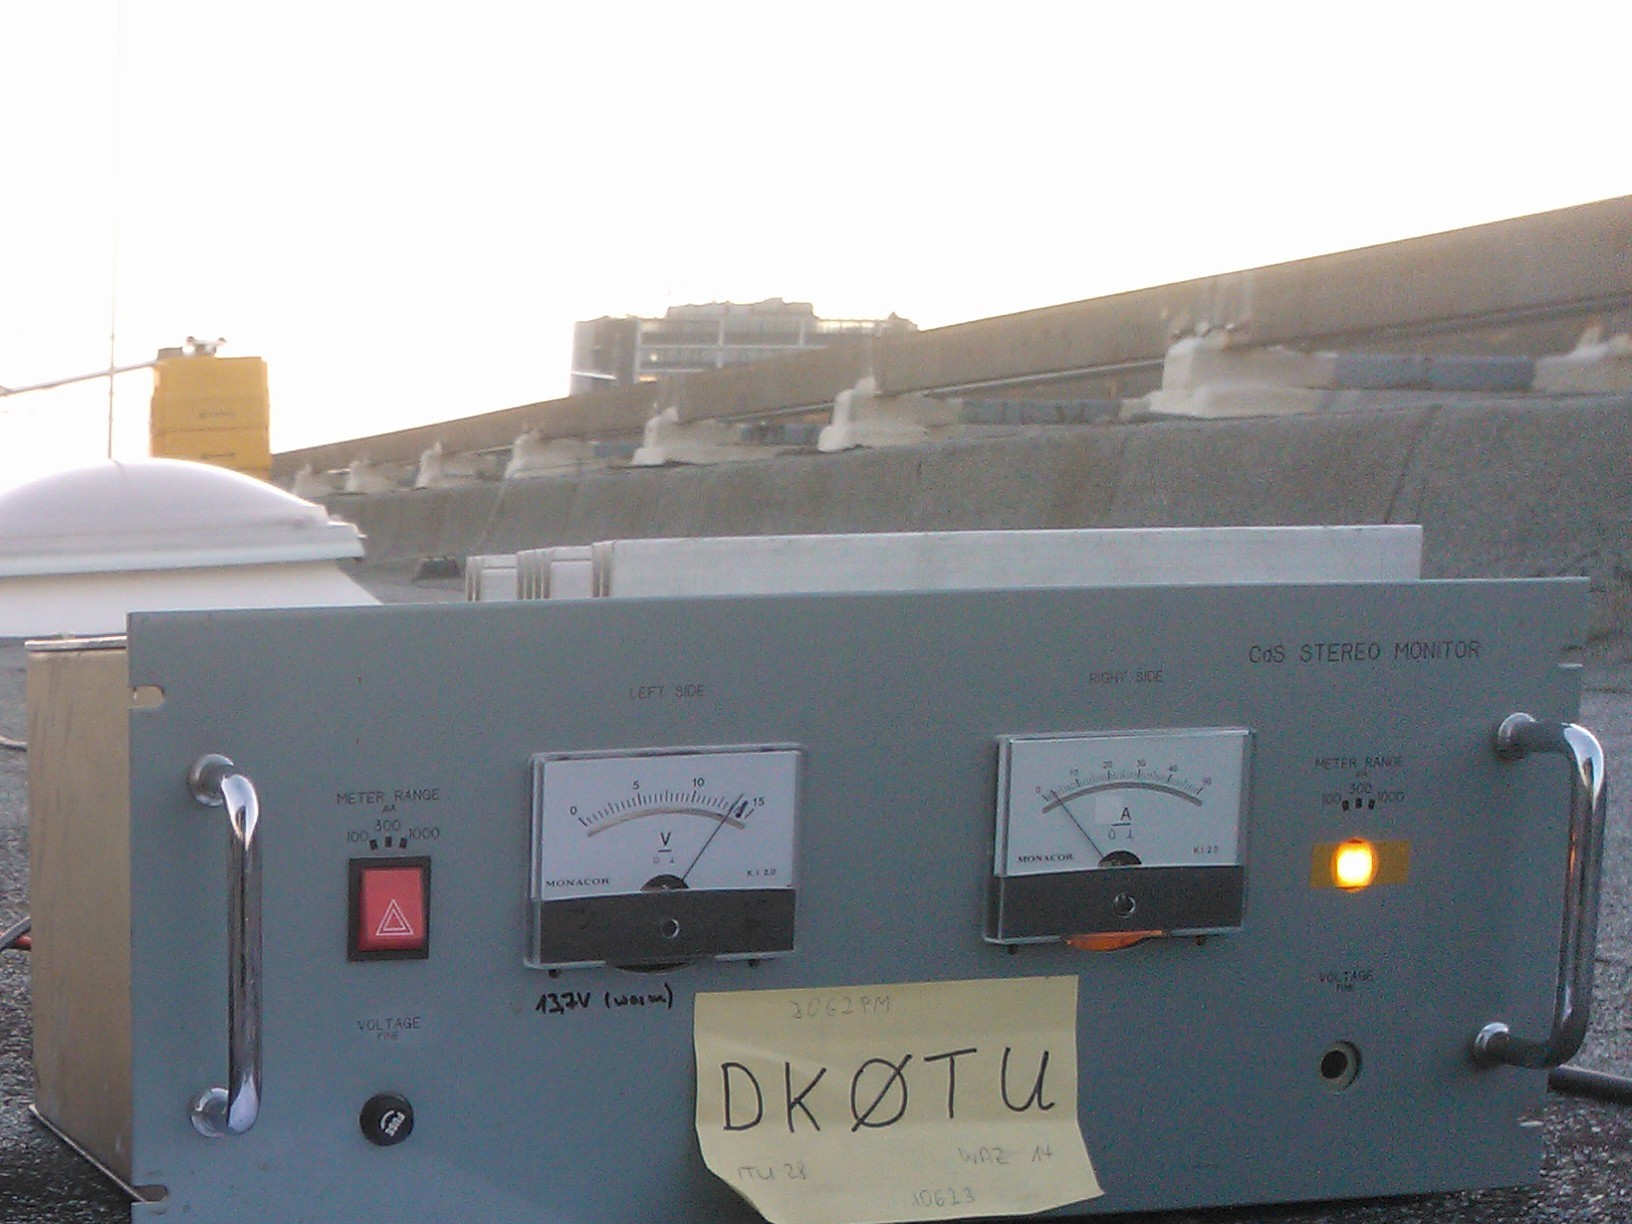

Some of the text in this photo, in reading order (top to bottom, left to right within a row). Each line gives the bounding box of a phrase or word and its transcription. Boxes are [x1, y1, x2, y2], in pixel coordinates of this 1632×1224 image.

[1249, 640, 1481, 664] CdS STEREO MONITOR
[1089, 670, 1164, 685] RIGHT SIDE
[628, 683, 705, 700] LEFT SIDE
[1315, 757, 1357, 770] METER
[337, 788, 440, 805] METER RANGE
[569, 777, 765, 816] 0 5 10 15
[1120, 807, 1132, 821] A
[374, 819, 401, 832] 300
[347, 827, 440, 843] 100 1000
[659, 831, 672, 846] V
[1017, 853, 1074, 863] MONACOR
[545, 877, 611, 888] MONACOR
[357, 1017, 421, 1031] VOLTAGE
